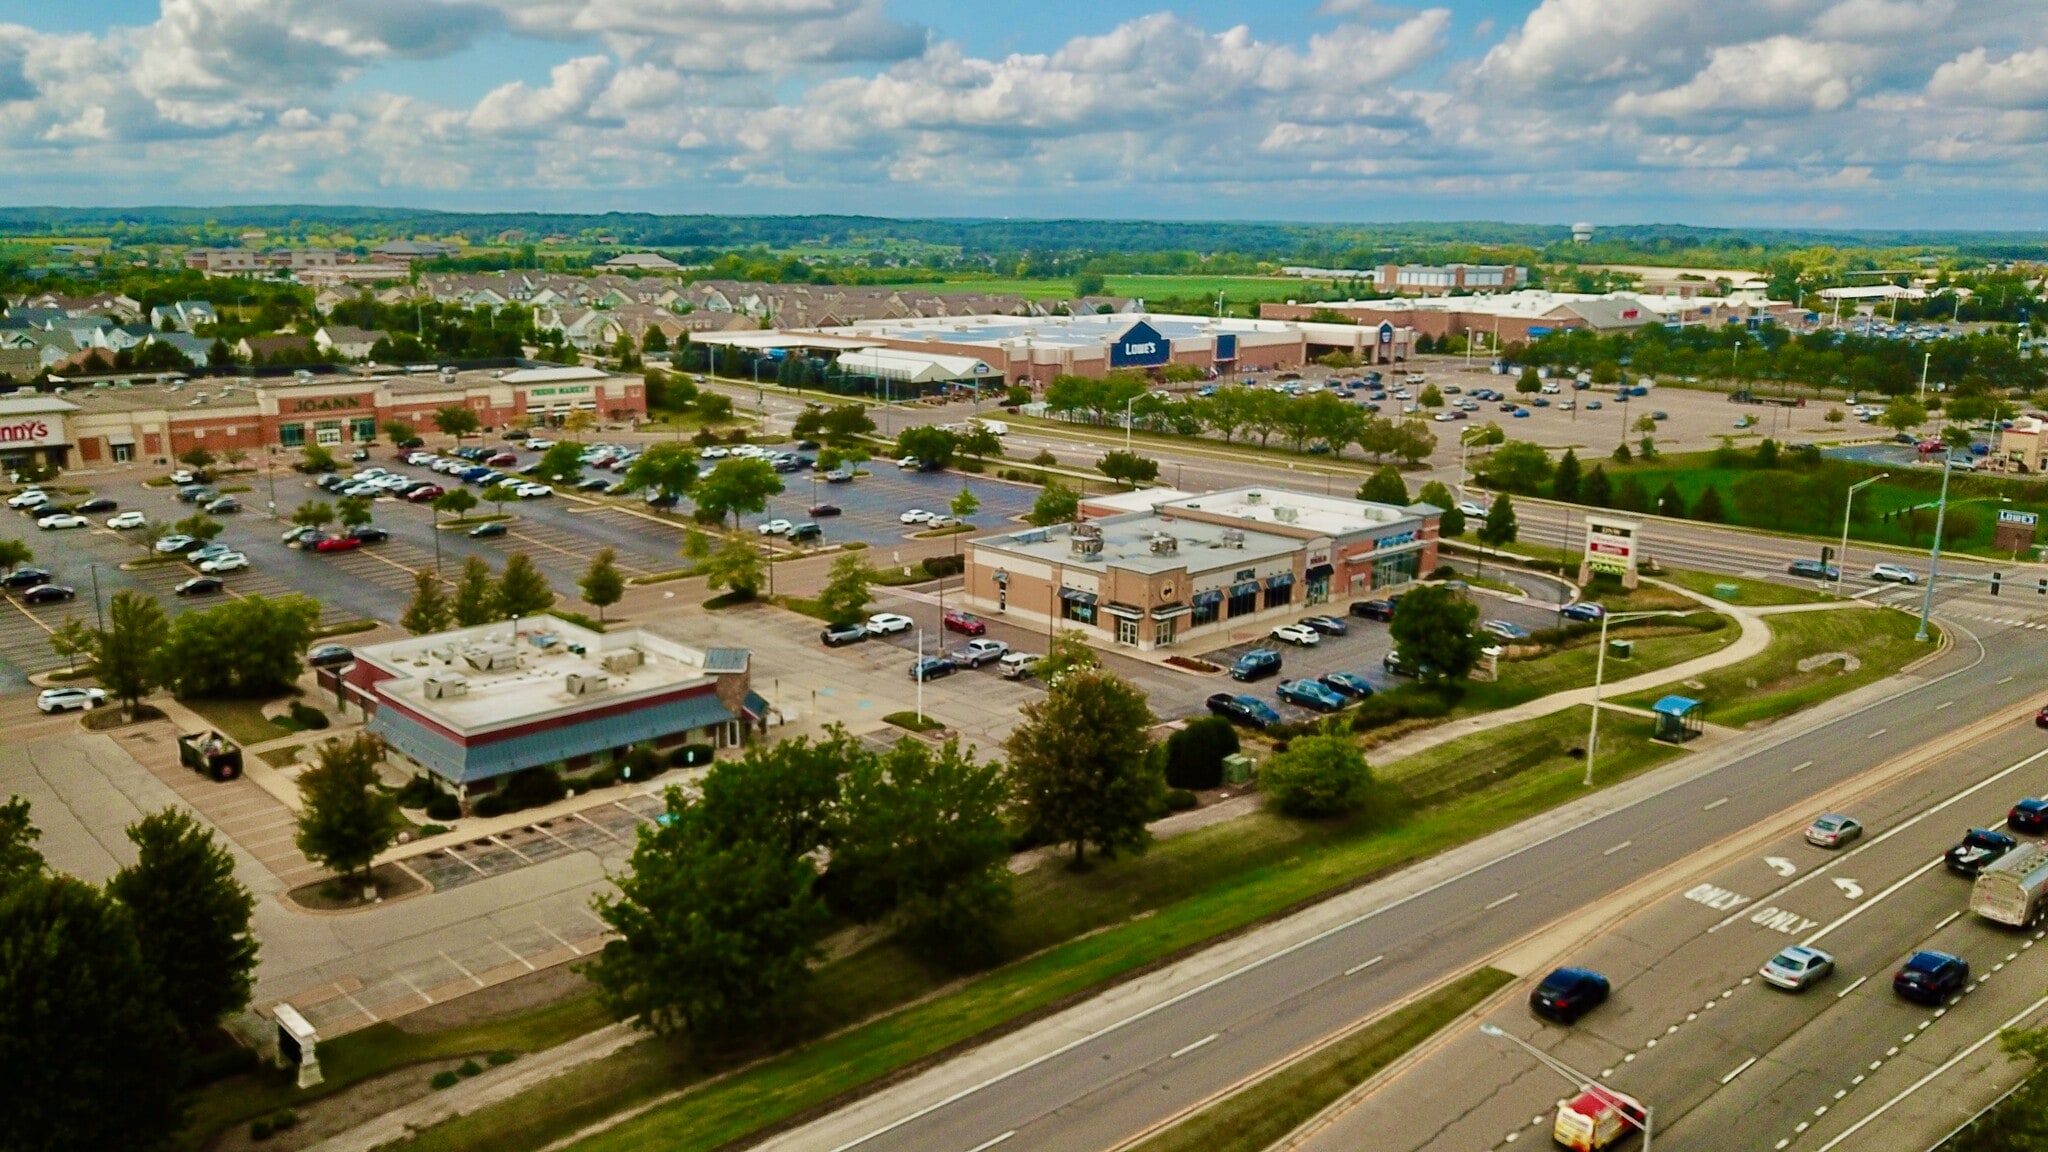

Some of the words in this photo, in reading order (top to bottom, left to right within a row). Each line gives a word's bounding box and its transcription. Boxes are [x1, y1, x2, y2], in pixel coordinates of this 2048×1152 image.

[1126, 342, 1156, 355] LOWE'S
[1684, 883, 1750, 911] ONLY
[1751, 907, 1818, 935] ONLY
